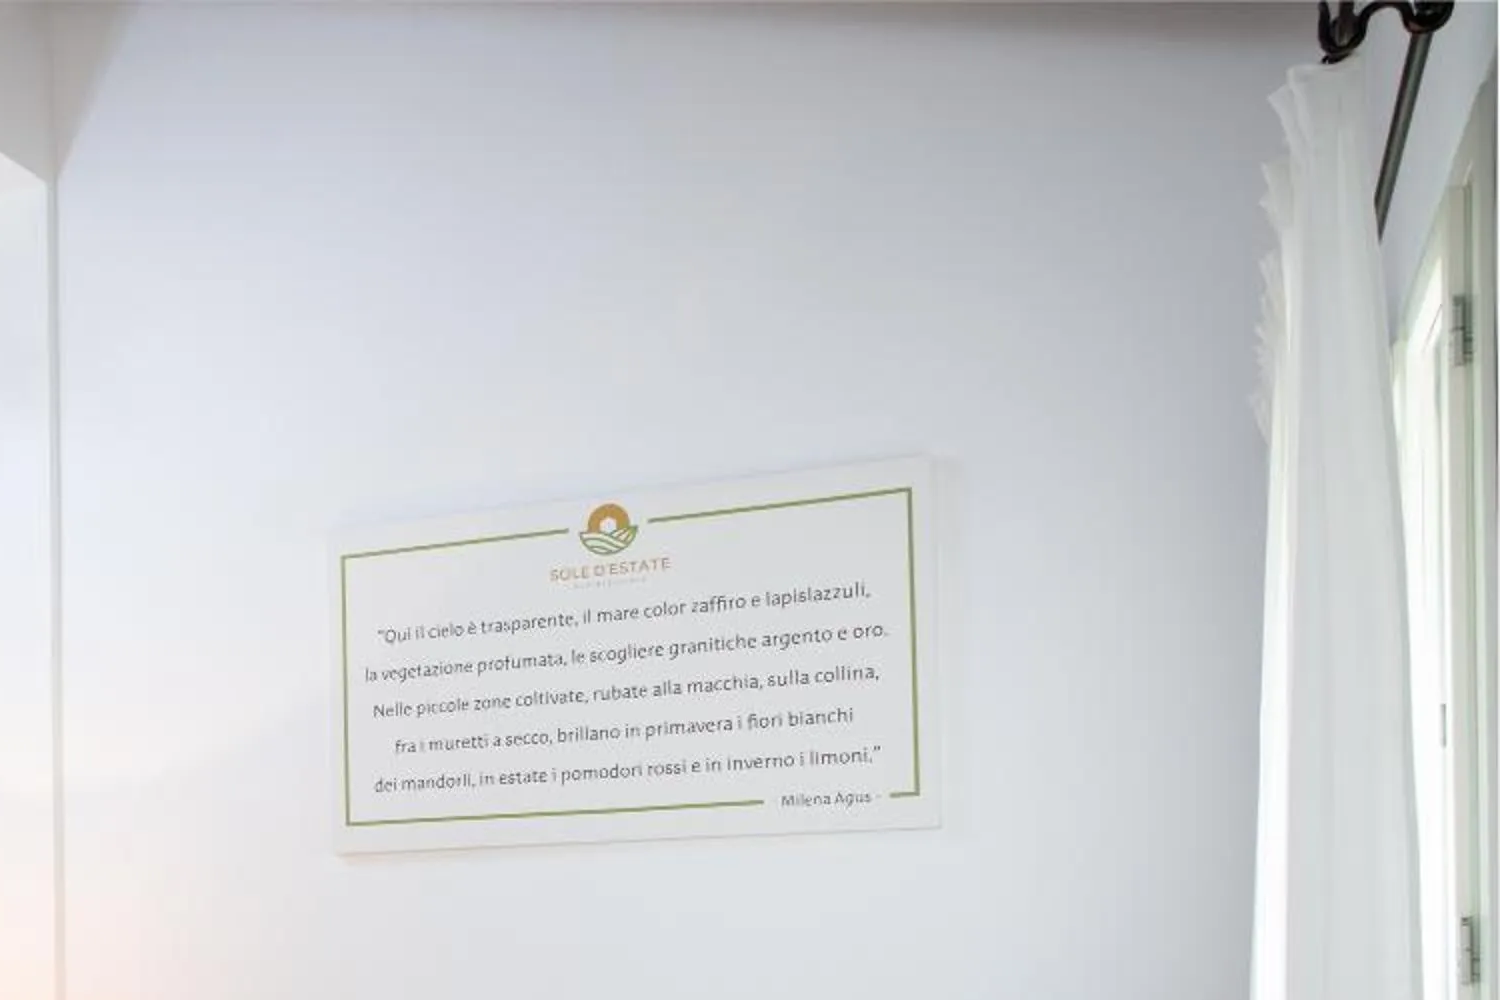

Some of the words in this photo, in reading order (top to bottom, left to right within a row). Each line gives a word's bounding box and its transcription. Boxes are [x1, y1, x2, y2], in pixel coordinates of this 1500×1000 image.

[549, 565, 590, 582] SOLE
[415, 625, 426, 641] il
[426, 622, 466, 640] cielo
[466, 620, 478, 636] è
[582, 608, 592, 625] il
[596, 607, 640, 623] mare
[643, 600, 688, 620] color
[691, 594, 748, 614] zaffiro
[750, 595, 762, 609] e
[365, 666, 379, 683] la
[381, 660, 474, 684] vegetazione
[570, 648, 587, 666] le
[589, 642, 665, 666] scogliere
[666, 633, 758, 661] granitiche
[760, 628, 834, 652] argento
[836, 628, 850, 641] e
[372, 701, 413, 719] Nelle
[415, 697, 470, 719] piccole
[472, 696, 512, 712] zone
[592, 684, 649, 702] rubate
[652, 679, 684, 697] alla
[766, 668, 811, 688] sulla
[394, 738, 417, 755] fra
[427, 733, 490, 752] muretti
[491, 735, 503, 748] a
[557, 725, 622, 744] brillano
[624, 723, 642, 739] in
[644, 718, 734, 742] primavera
[746, 712, 784, 731] fiori
[787, 706, 854, 727] bianchi
[373, 776, 398, 794] dei
[478, 771, 496, 787] in
[498, 770, 549, 786] estate
[560, 762, 643, 787] pomodori
[646, 758, 687, 777] rossi
[690, 760, 702, 774] e
[705, 756, 723, 773] in
[726, 754, 796, 771] inverno
[780, 792, 832, 809] Milena
[833, 790, 874, 809] Agus
